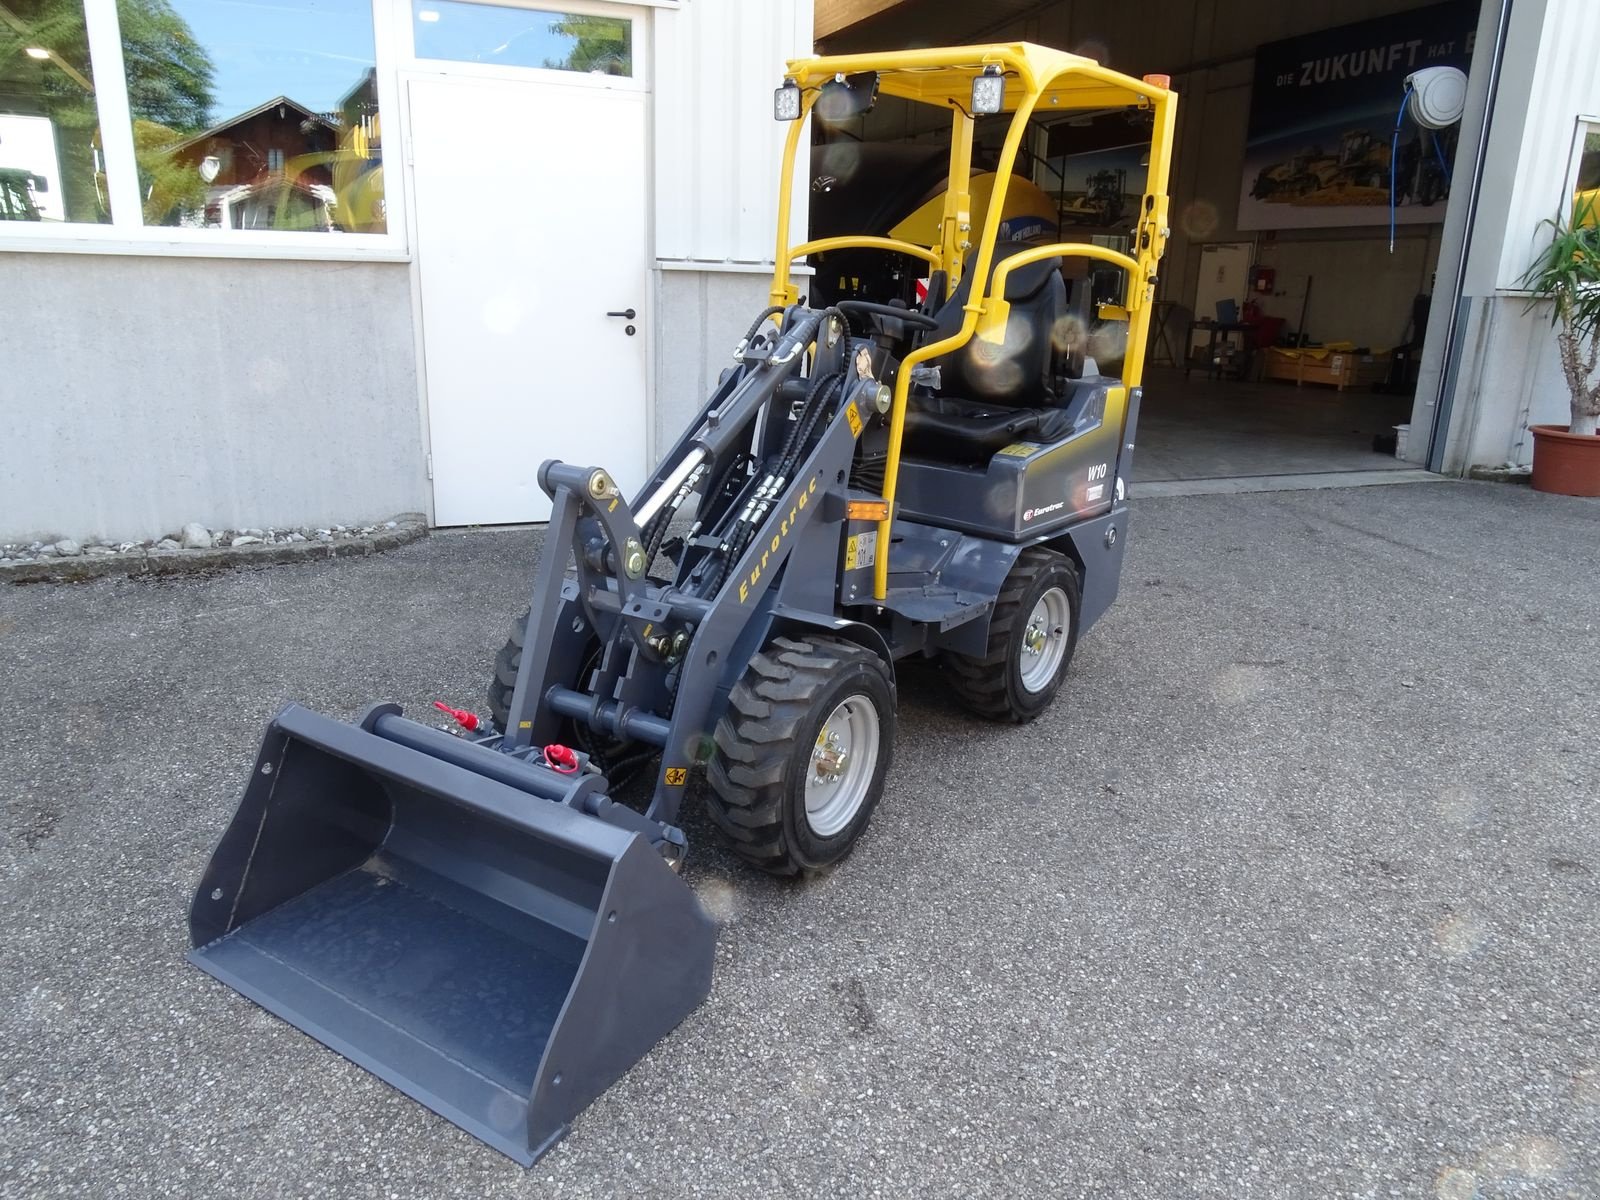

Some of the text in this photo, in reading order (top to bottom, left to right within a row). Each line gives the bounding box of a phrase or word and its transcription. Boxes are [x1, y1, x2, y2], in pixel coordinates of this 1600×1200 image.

[1276, 72, 1294, 88] DIE
[1299, 40, 1423, 86] ZUKUNFT
[1428, 42, 1455, 58] HAT
[1088, 463, 1106, 481] W10
[1034, 502, 1064, 517] Eurotrac
[738, 476, 817, 603] Eurotrac
